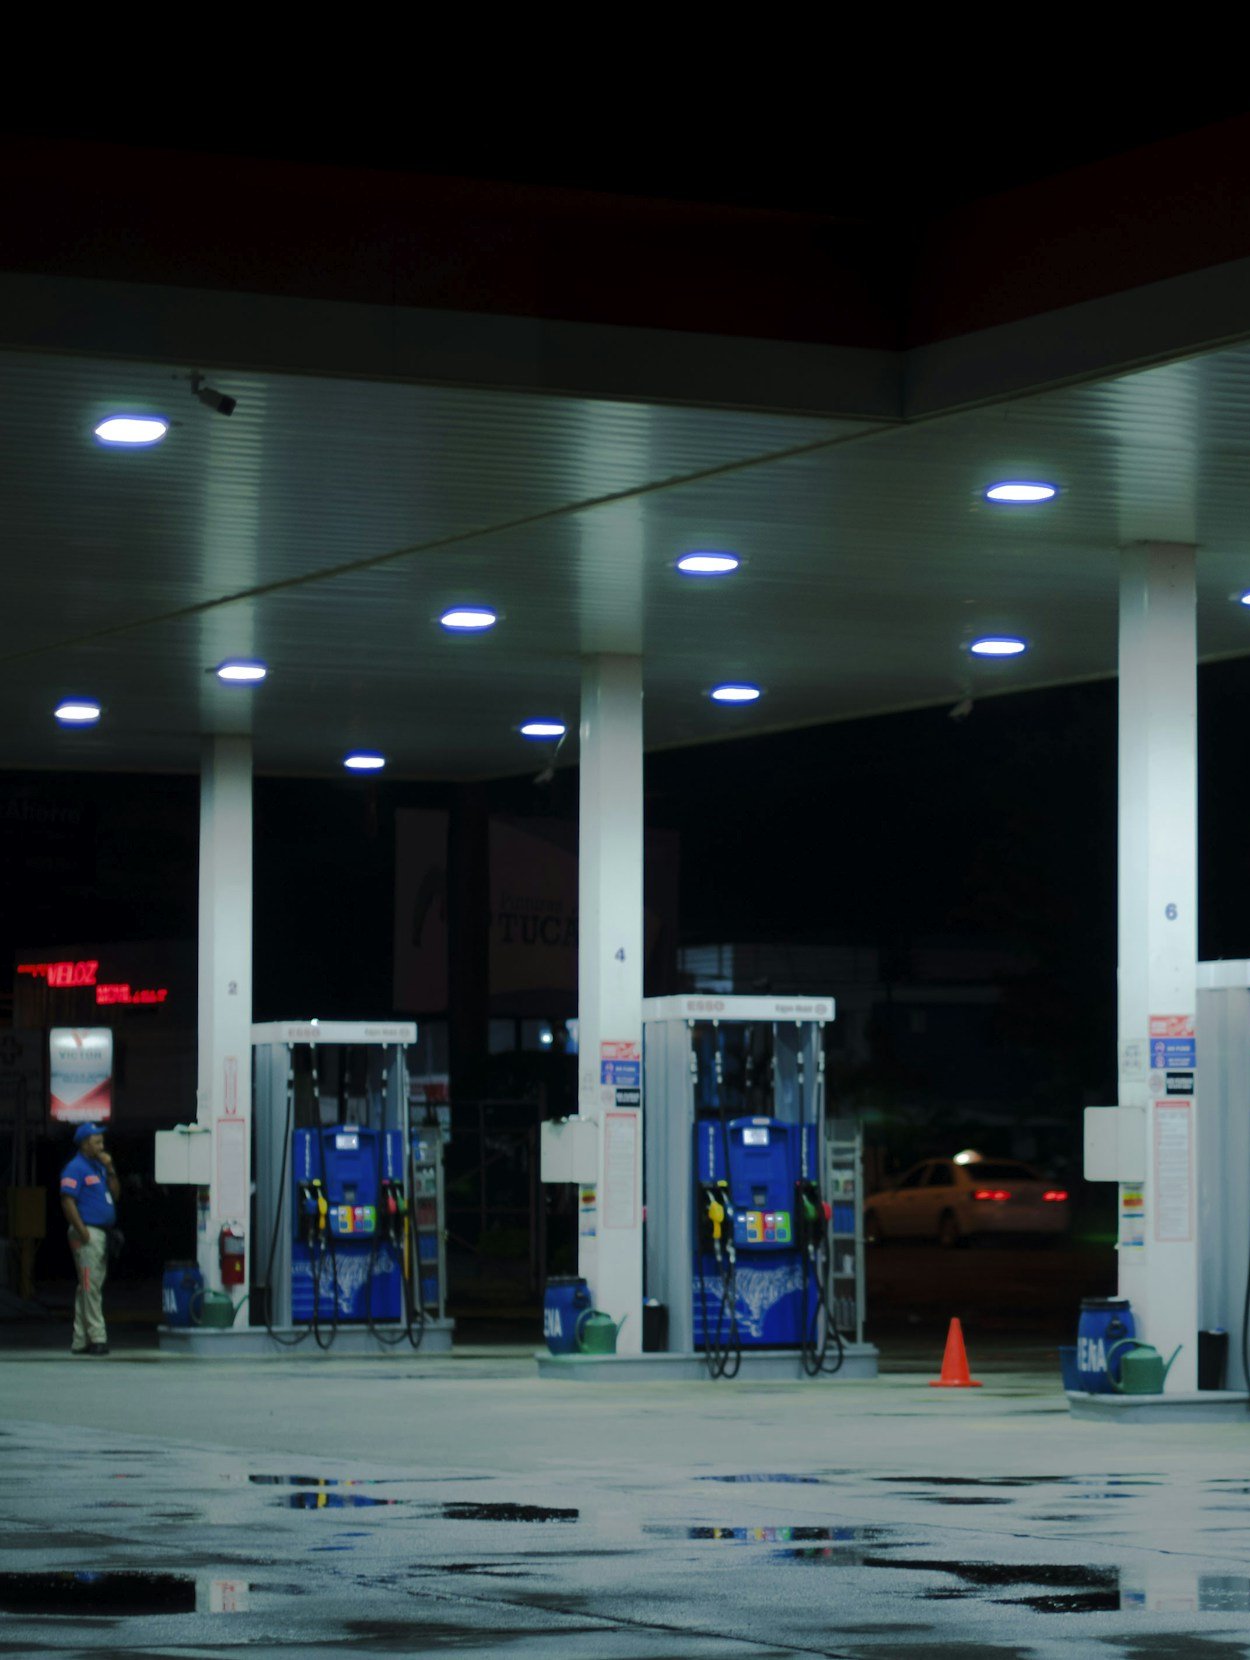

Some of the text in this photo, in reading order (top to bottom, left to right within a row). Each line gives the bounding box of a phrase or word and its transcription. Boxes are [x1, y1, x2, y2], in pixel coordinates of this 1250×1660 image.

[1164, 902, 1178, 921] 6
[614, 947, 625, 963] 4
[48, 960, 98, 987] VELOZ
[228, 980, 237, 996] 2
